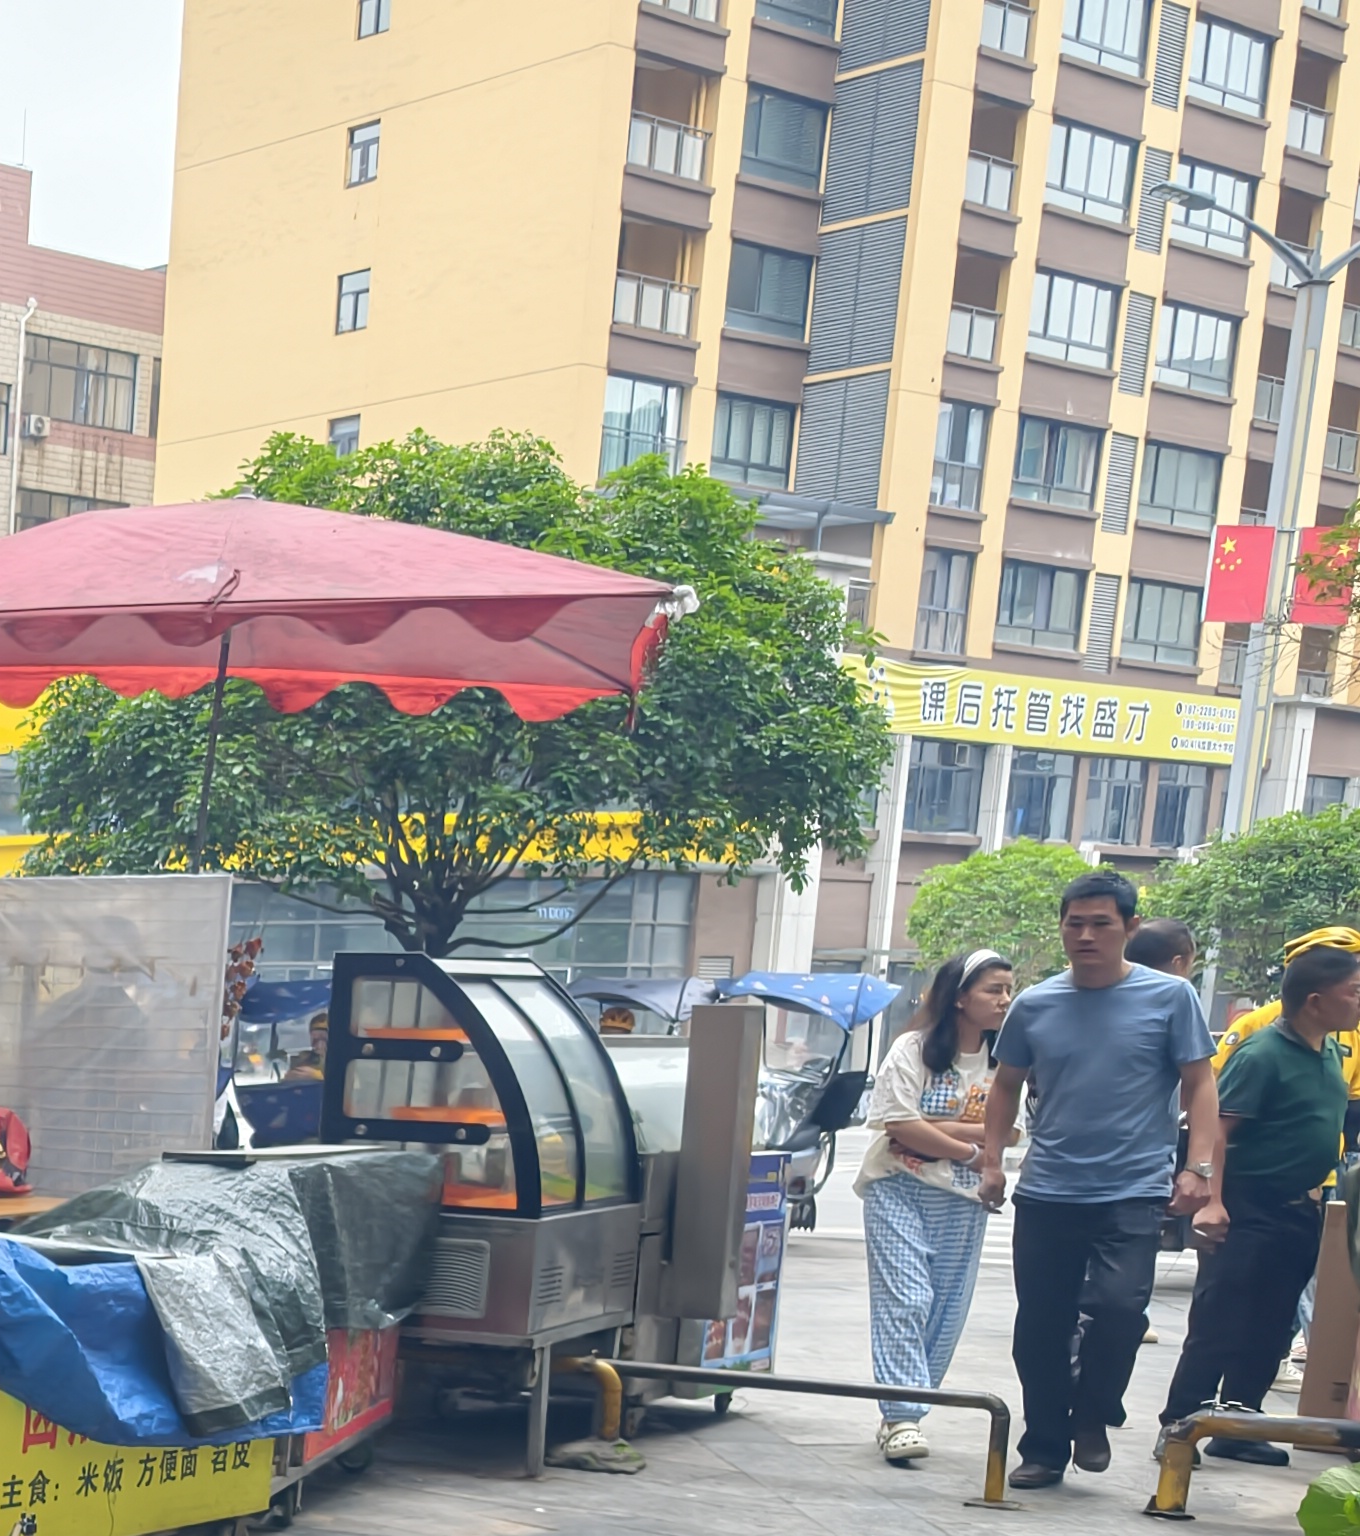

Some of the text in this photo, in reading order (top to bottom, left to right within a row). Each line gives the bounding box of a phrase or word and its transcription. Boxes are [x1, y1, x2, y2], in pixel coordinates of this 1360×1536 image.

[921, 681, 1151, 743] 课后托管找盛才
[76, 1457, 124, 1498] 米饭
[137, 1447, 198, 1488] 方便面
